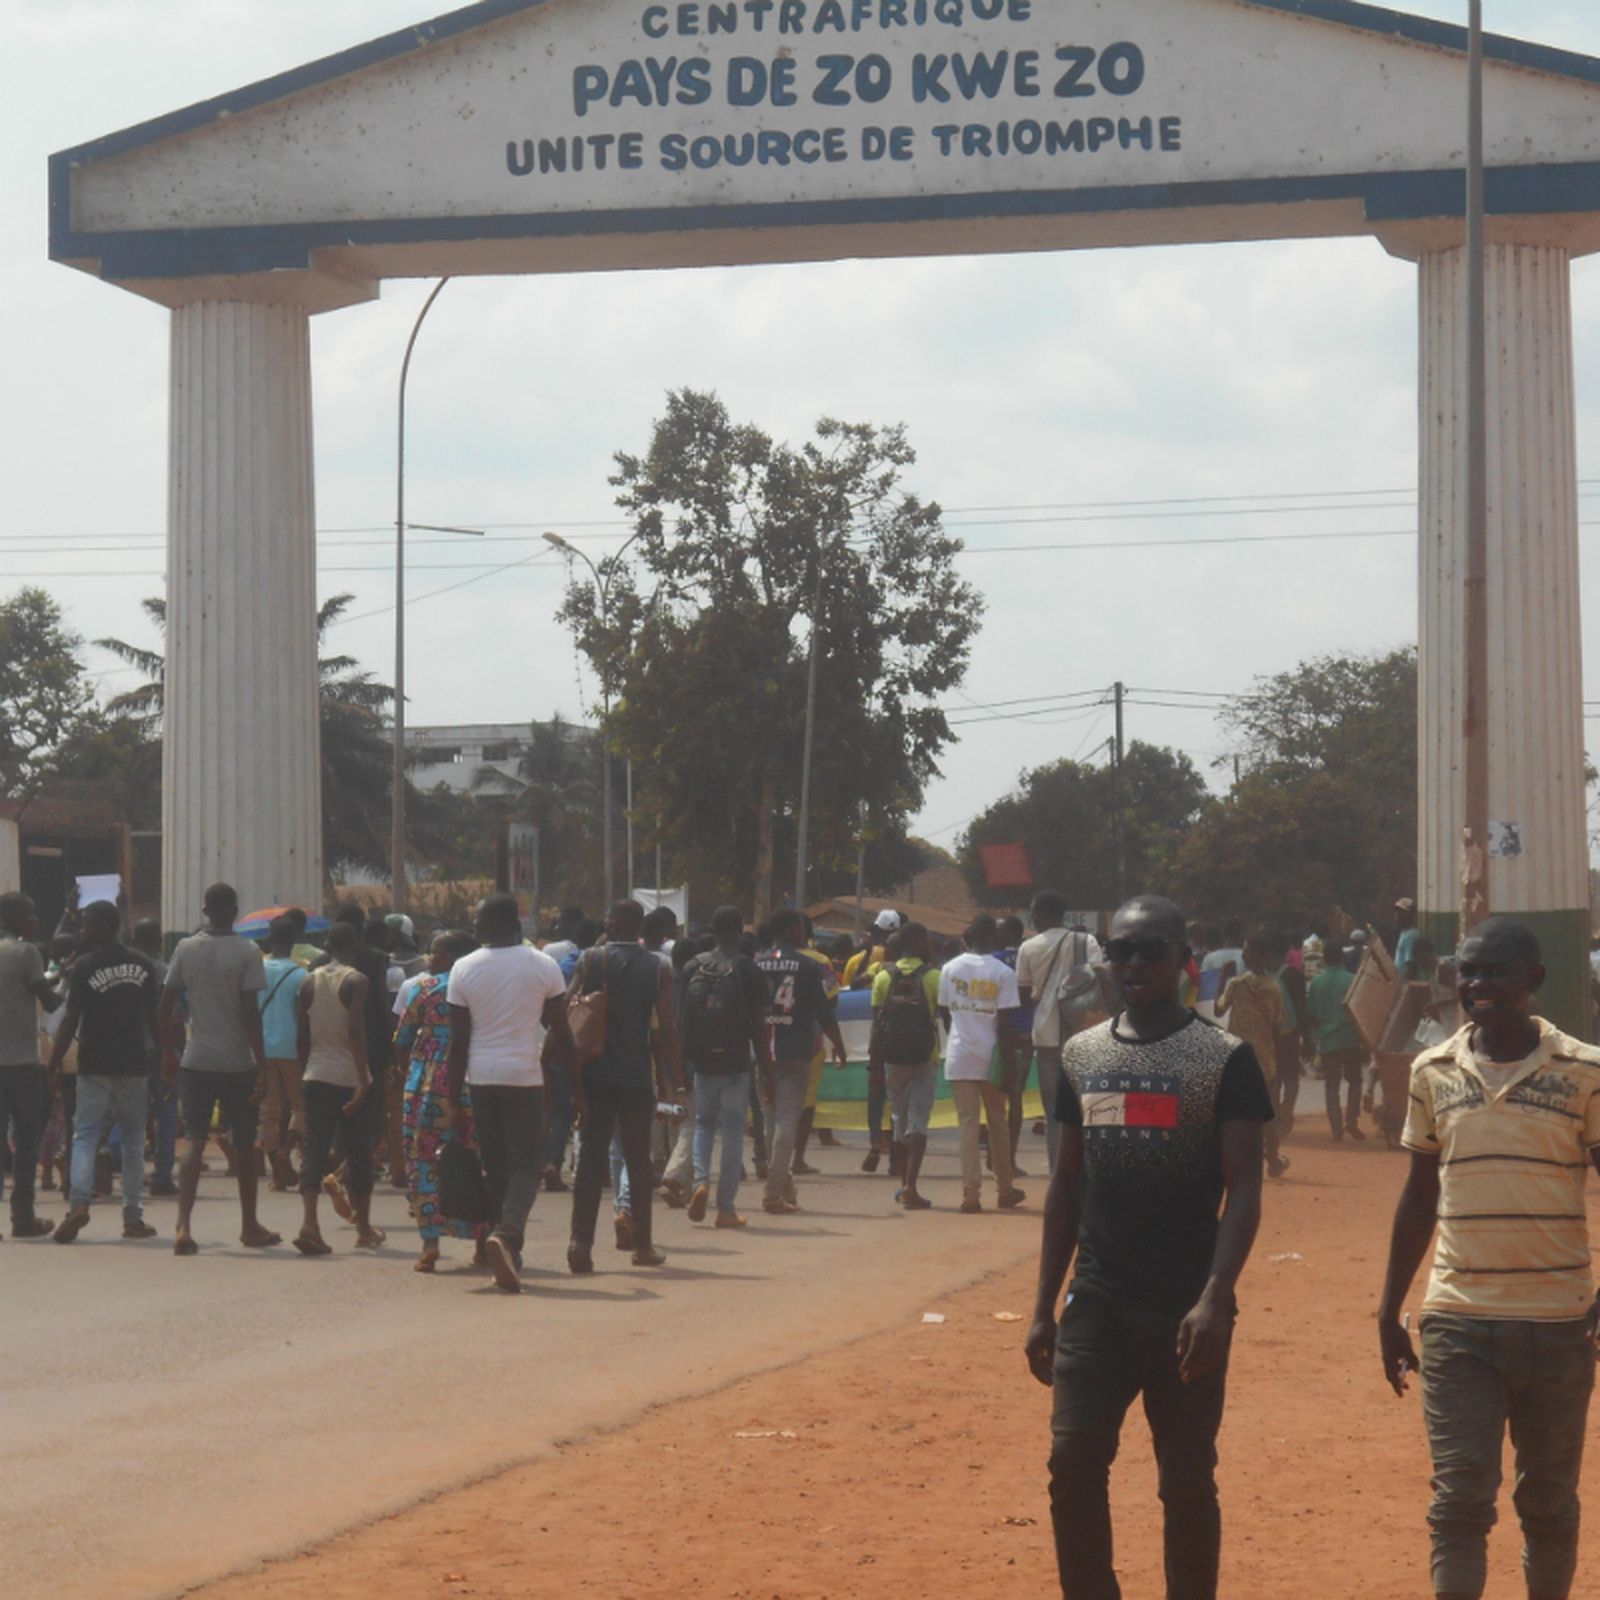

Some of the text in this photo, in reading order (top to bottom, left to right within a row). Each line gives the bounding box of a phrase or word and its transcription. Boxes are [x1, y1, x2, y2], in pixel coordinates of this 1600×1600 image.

[642, 0, 1031, 39] CENTRAFRIQUE
[574, 42, 1146, 117] PAYS DE ZO KWE ZO
[507, 116, 1182, 177] UNITE SOURCE DE TRIOMPHE
[774, 975, 796, 1013] 4
[1085, 1080, 1169, 1091] TOMMY
[1084, 1129, 1169, 1140] JEANS
